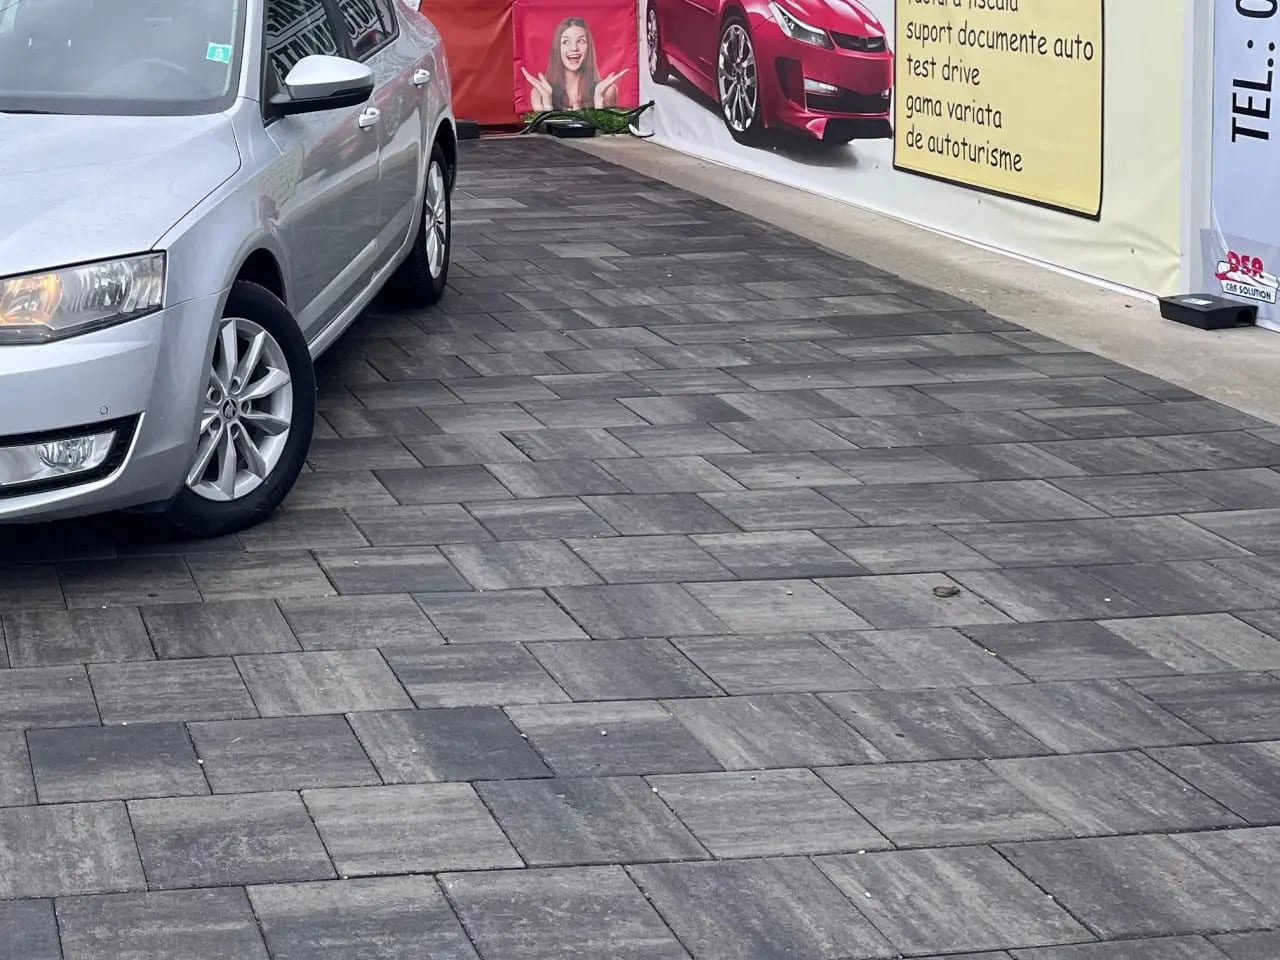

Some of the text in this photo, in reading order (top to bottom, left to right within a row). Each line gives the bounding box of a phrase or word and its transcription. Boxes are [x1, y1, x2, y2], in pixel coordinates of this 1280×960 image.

[906, 19, 1095, 61] suport documente auto
[906, 53, 981, 86] test drive
[905, 94, 1003, 129] gama variata
[905, 123, 1024, 173] de autoturisme
[1226, 249, 1264, 278] DSA
[1225, 281, 1272, 301] CAR SOLUTION
